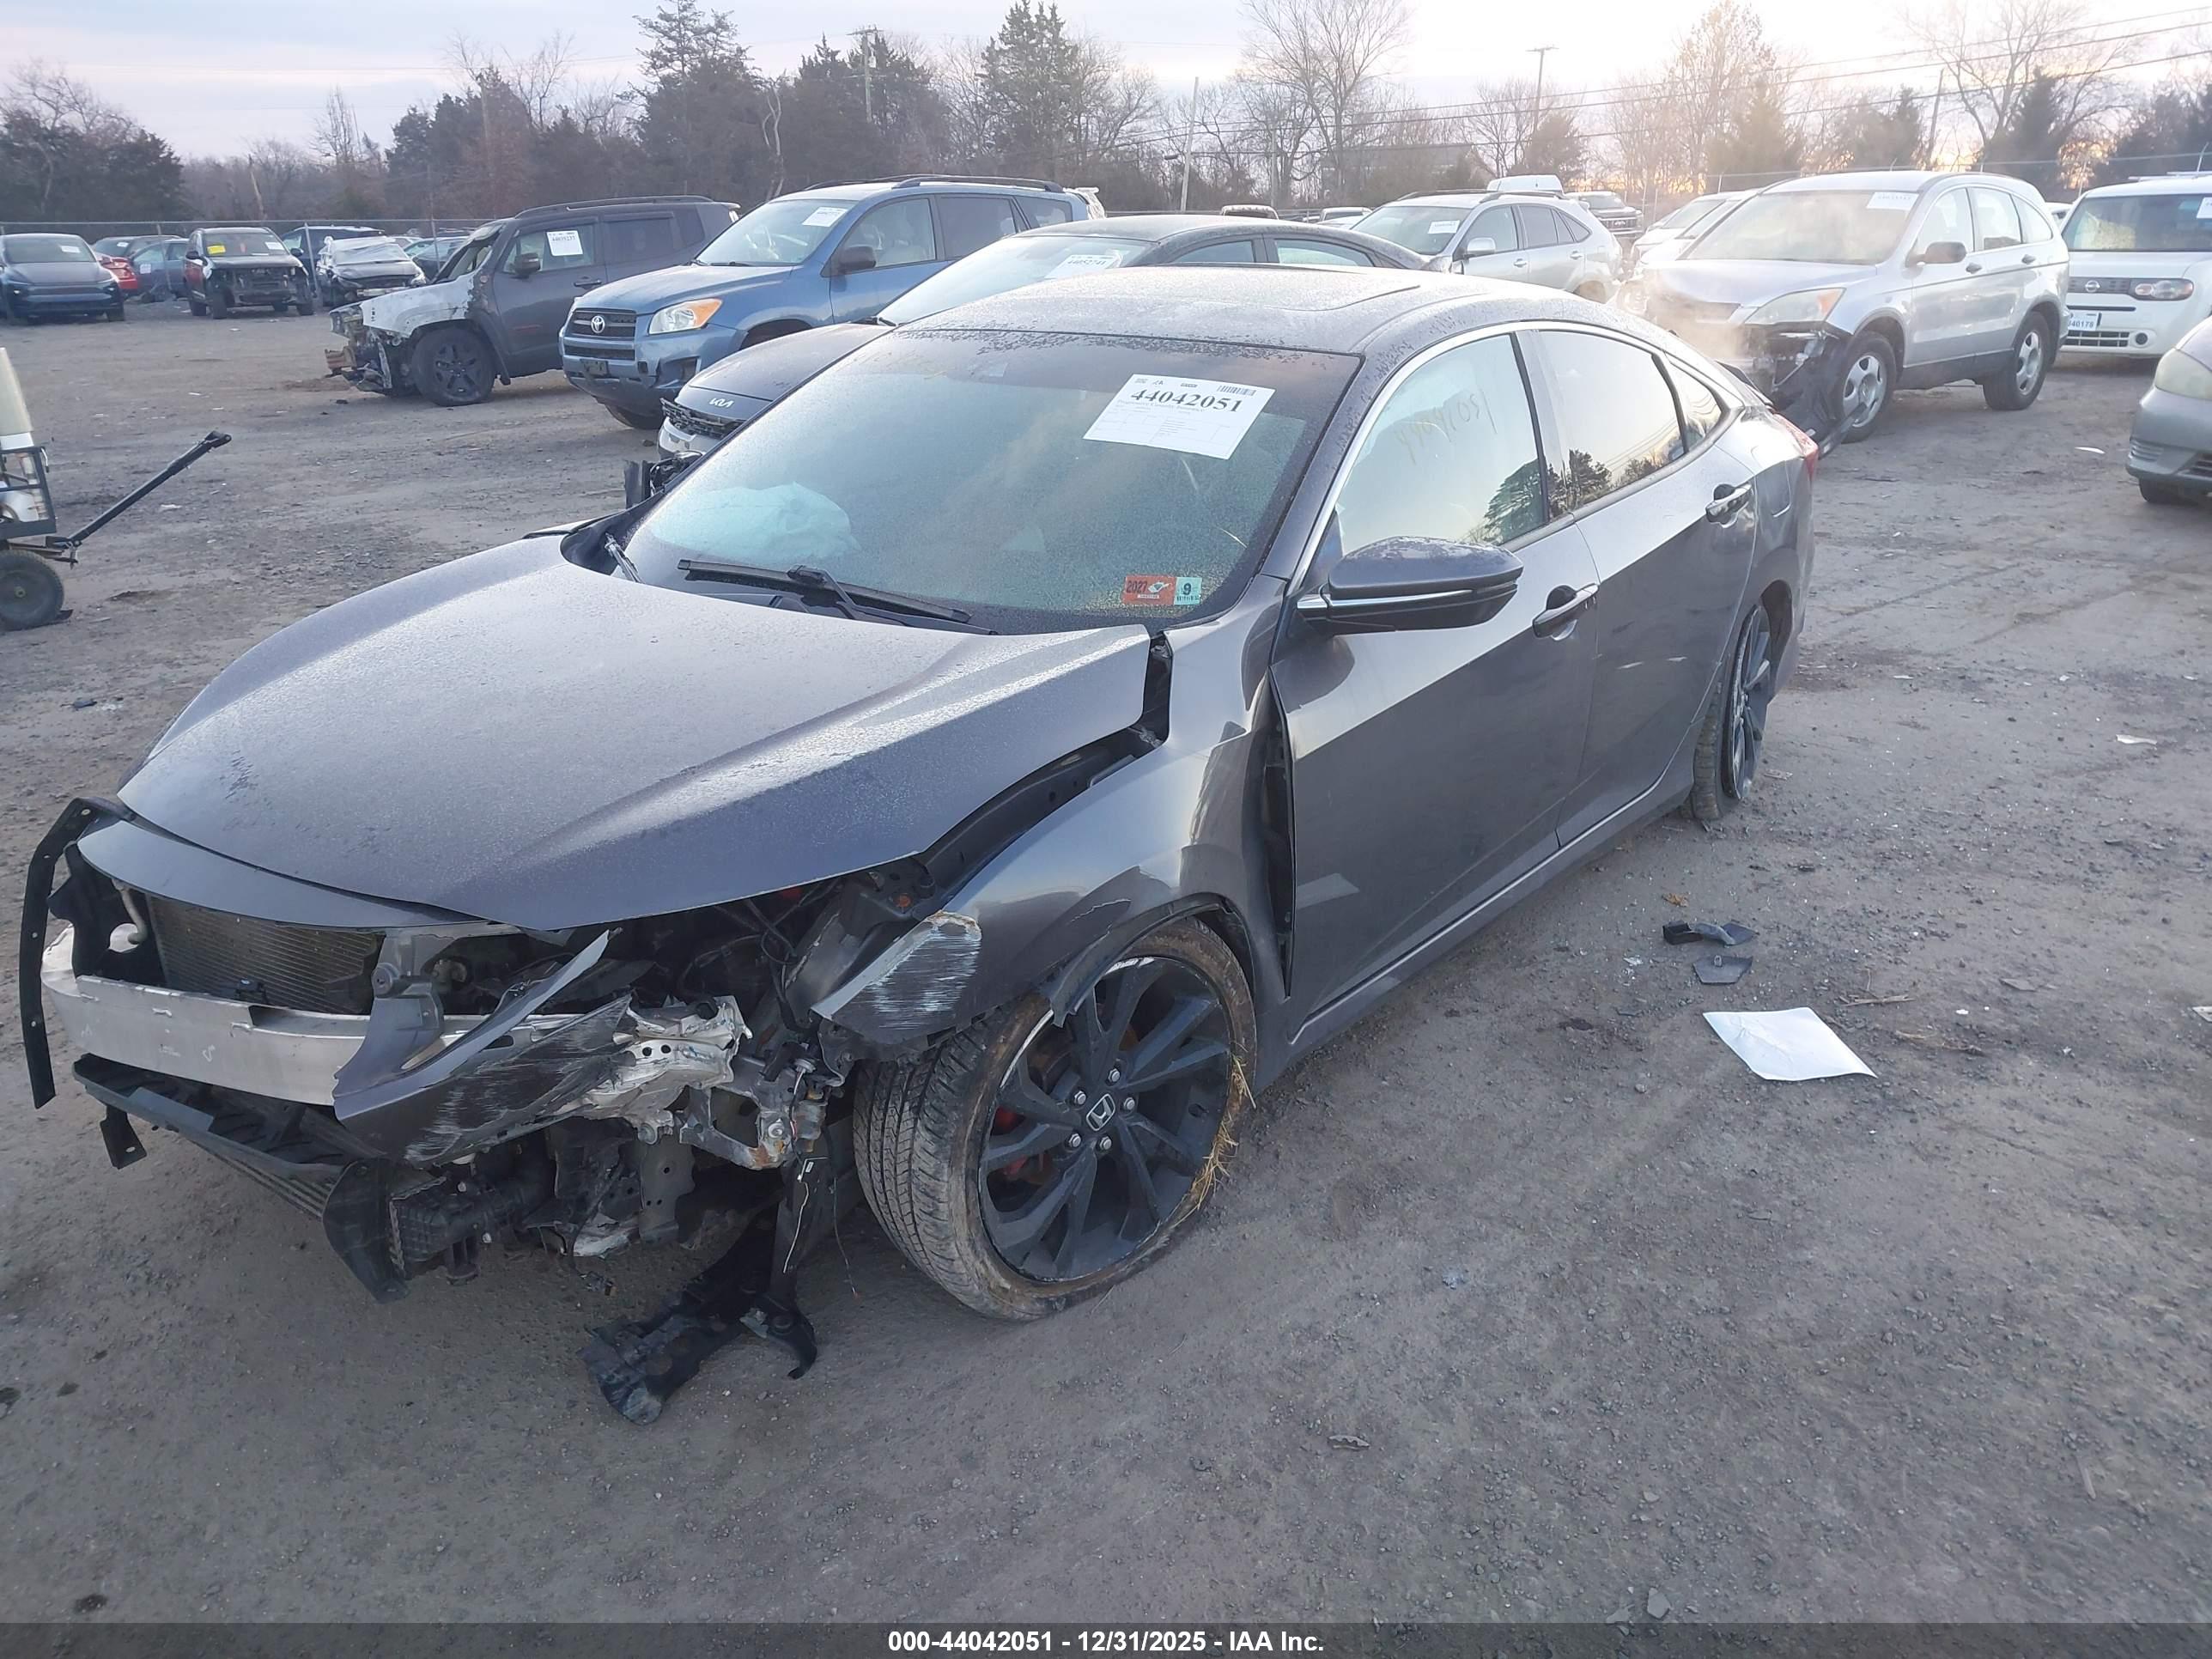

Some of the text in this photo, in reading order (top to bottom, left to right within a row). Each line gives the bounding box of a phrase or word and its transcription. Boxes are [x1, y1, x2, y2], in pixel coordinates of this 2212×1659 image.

[1130, 389, 1243, 412] 44042051
[1126, 580, 1148, 593] 2027
[1183, 583, 1192, 595] 9
